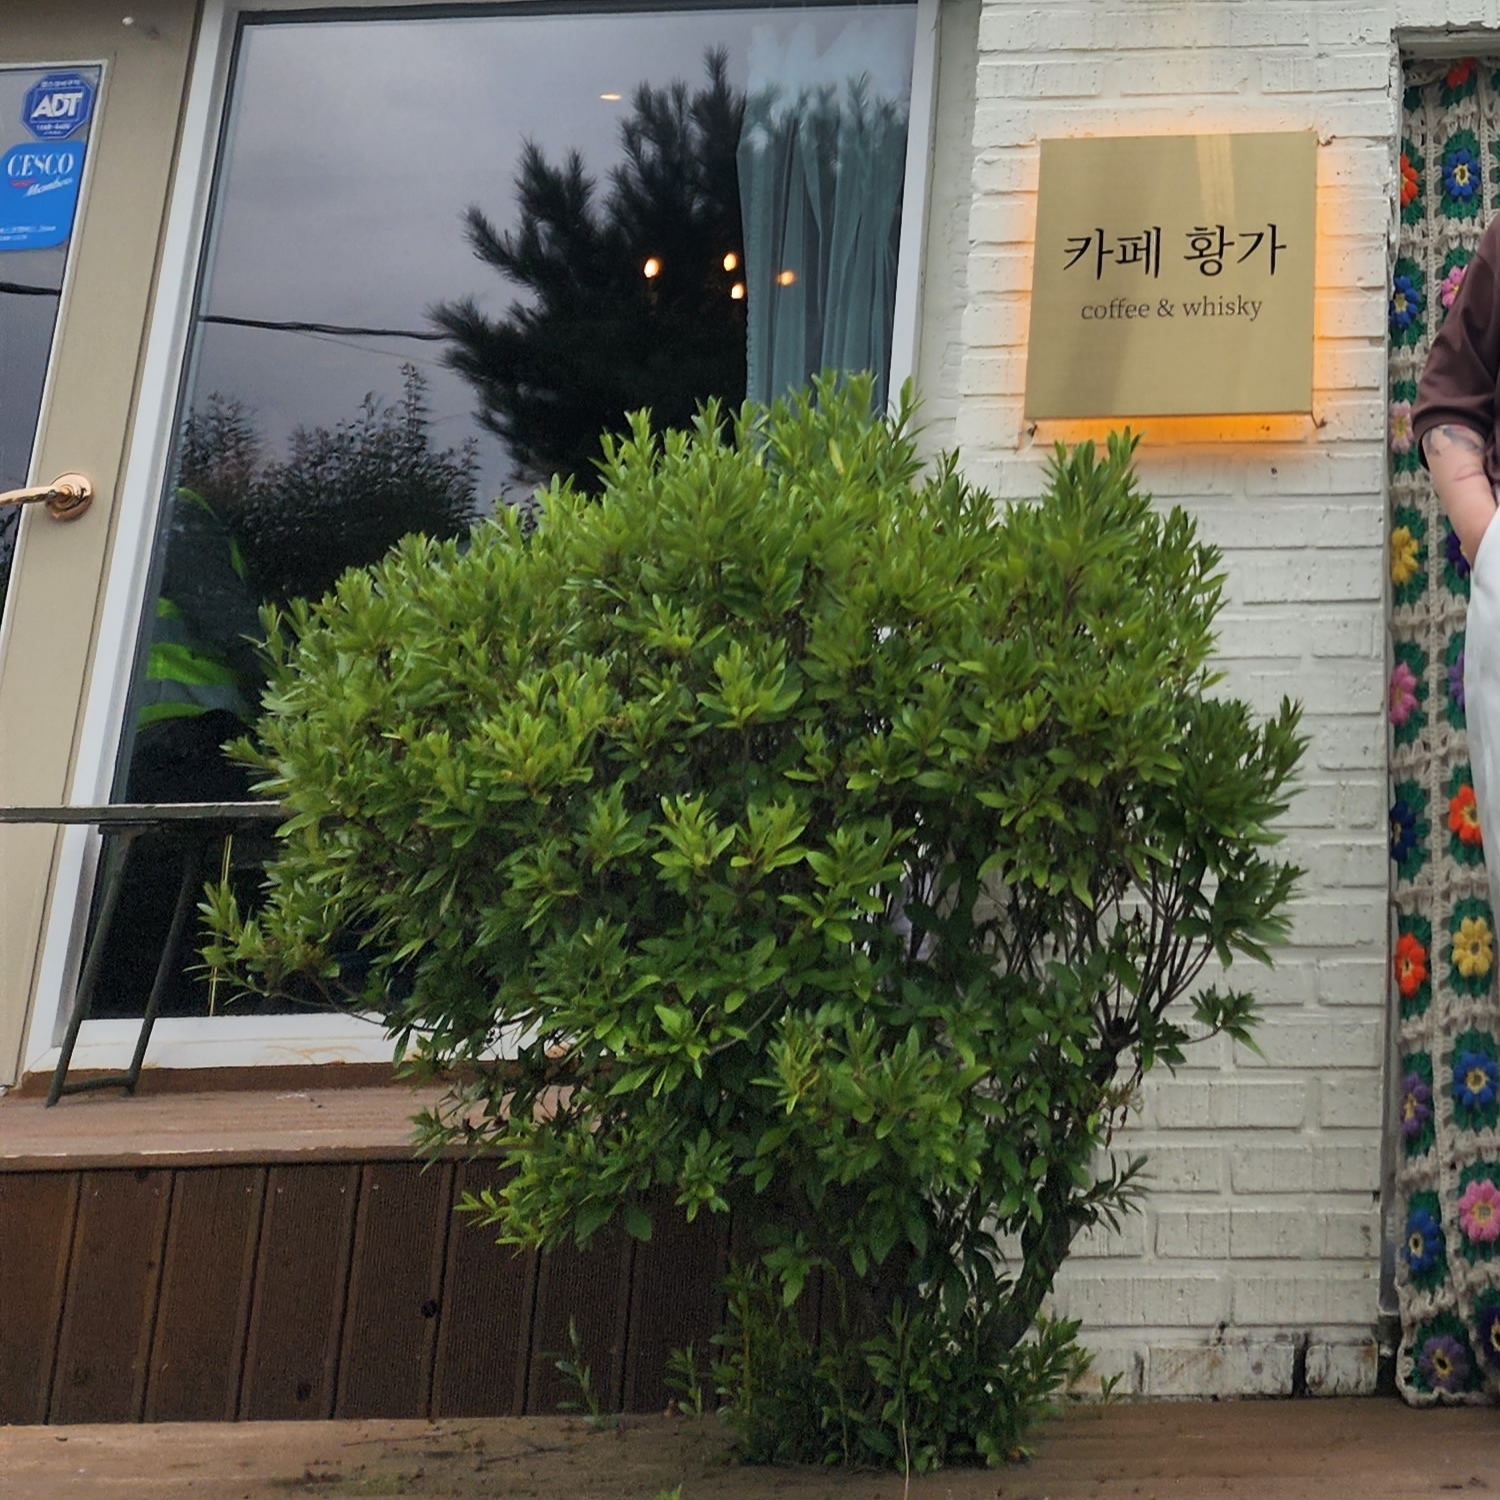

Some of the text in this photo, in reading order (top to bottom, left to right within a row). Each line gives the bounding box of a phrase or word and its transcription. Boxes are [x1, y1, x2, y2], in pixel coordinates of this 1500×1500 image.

[30, 92, 84, 118] ADT
[7, 152, 75, 177] CESCO
[1063, 223, 1287, 281] 카페 황가
[1081, 295, 1263, 322] coffee & whisky
